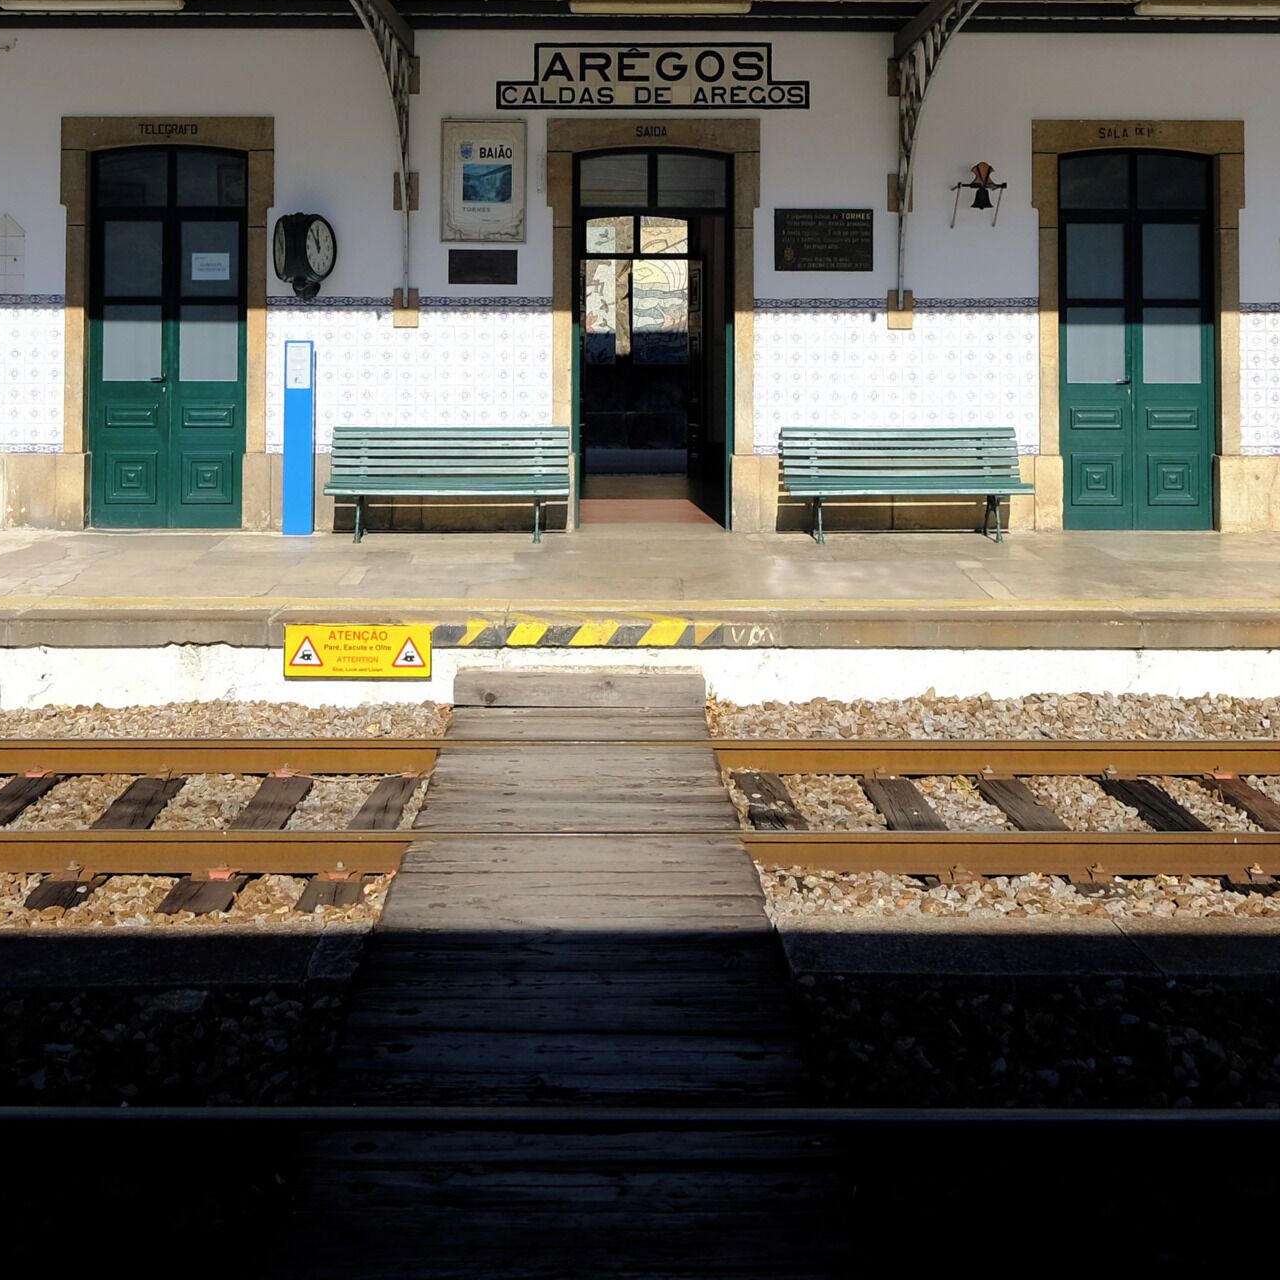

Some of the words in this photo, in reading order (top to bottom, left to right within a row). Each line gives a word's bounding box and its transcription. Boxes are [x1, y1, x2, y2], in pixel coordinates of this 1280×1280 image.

[541, 47, 765, 83] ARÊGOS
[501, 86, 614, 105] CALDAS
[634, 86, 671, 104] DE
[1098, 127, 1129, 139] SALA
[479, 144, 513, 159] BAIÃO
[328, 629, 388, 644] ATENÇÃO
